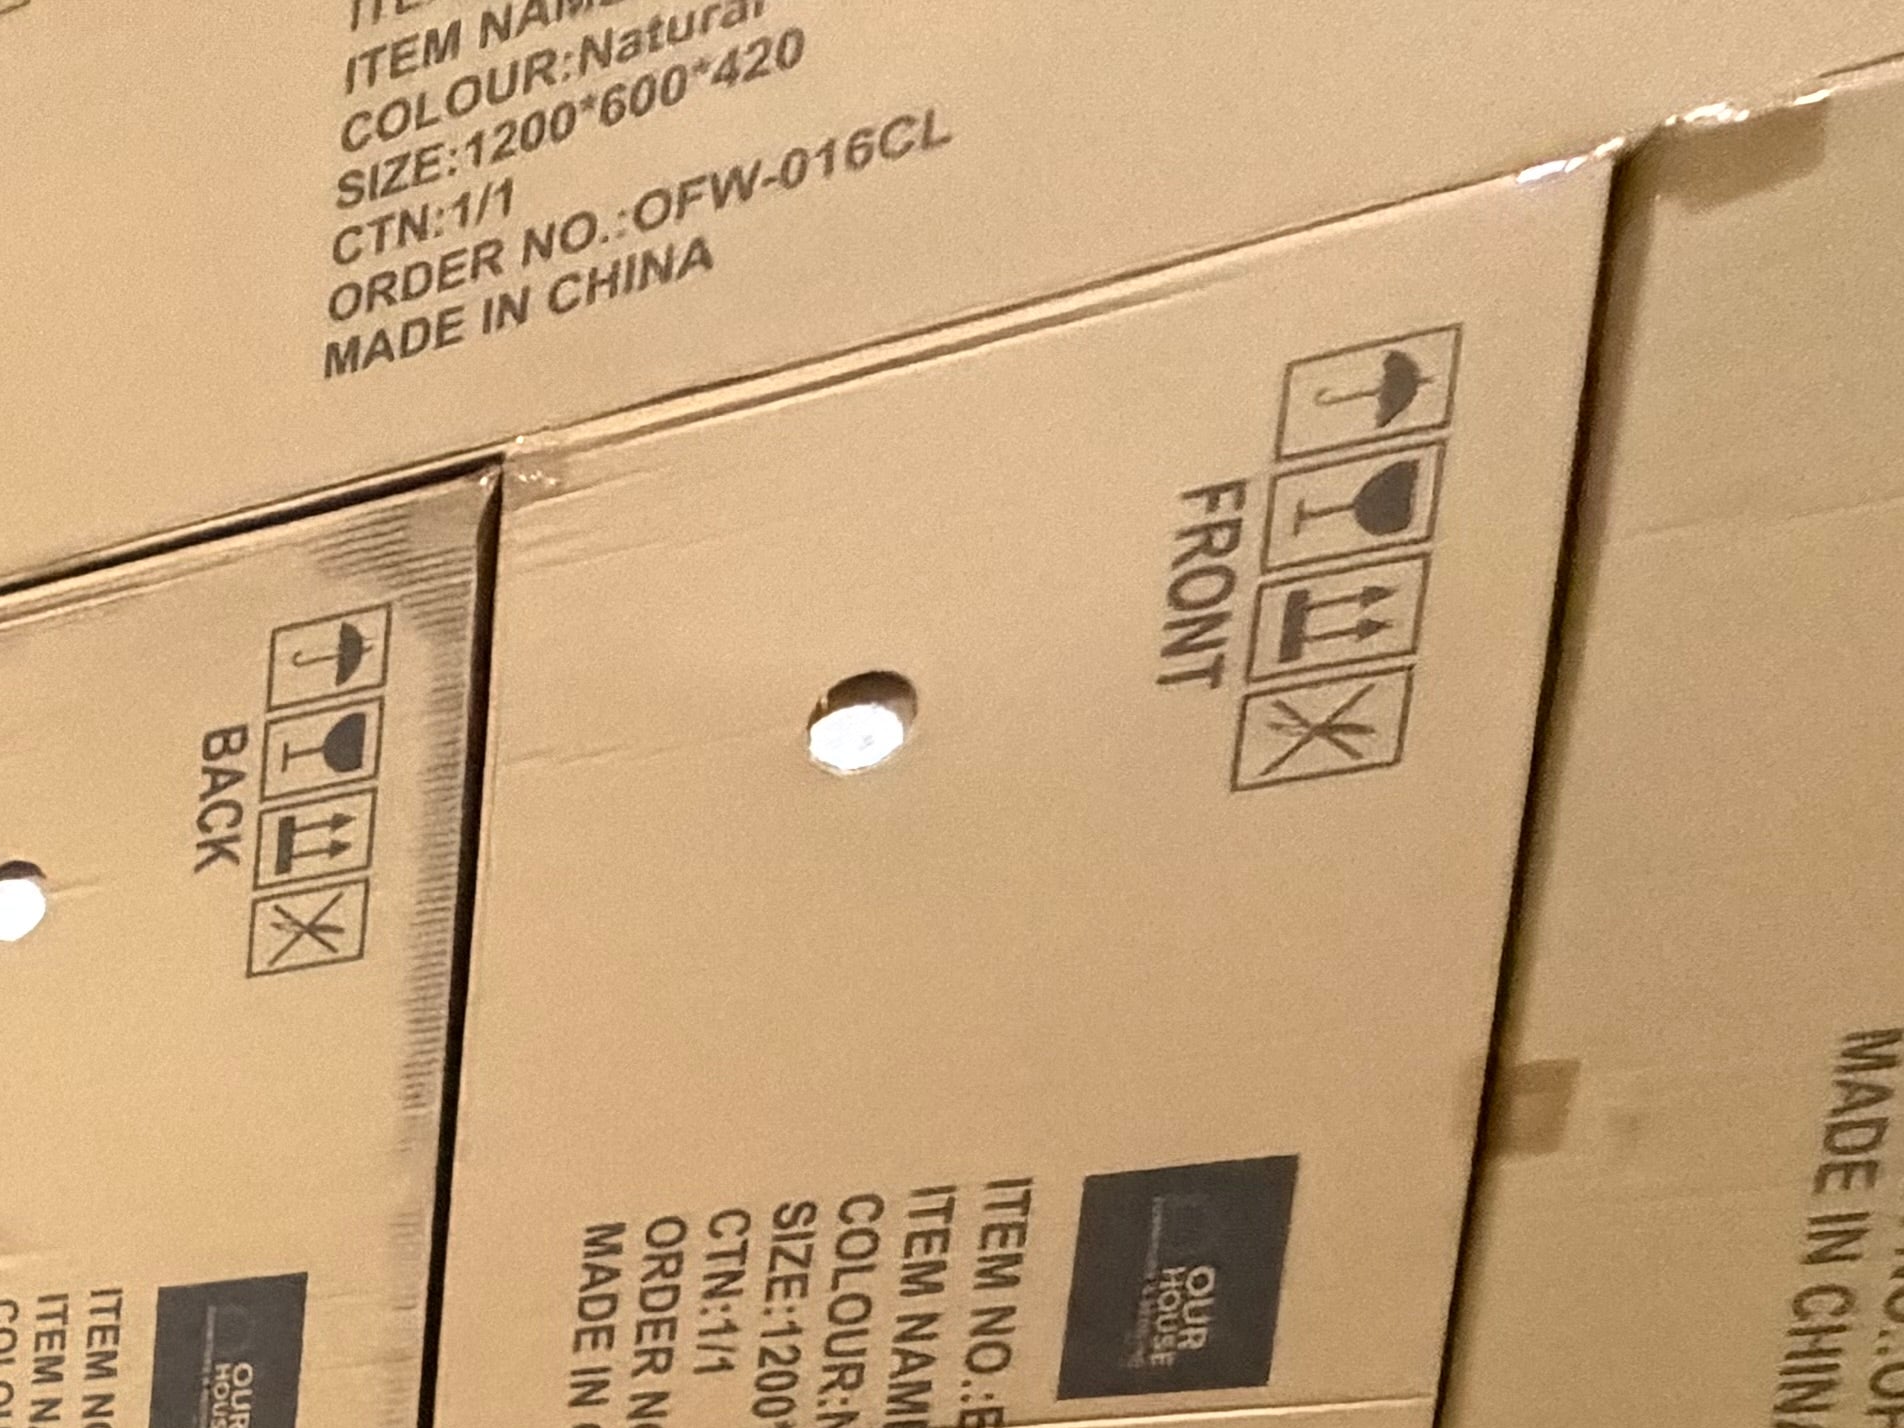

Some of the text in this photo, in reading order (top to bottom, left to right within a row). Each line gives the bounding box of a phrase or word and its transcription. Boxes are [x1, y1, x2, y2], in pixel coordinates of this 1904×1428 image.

[345, 19, 462, 95] ITEM
[328, 109, 952, 321] ORDER NO.:OFW-016CL
[332, 177, 514, 265] CTN:1/1
[324, 236, 713, 379] MADE IN CHINA
[1157, 478, 1250, 689] FRONT
[194, 723, 248, 872] BACK
[1813, 1026, 1902, 1196] MADE
[571, 1222, 626, 1356] MADE
[692, 1208, 752, 1376] CTN:1/1
[898, 1184, 958, 1300] ITEM
[972, 1176, 1034, 1292] ITEM
[1802, 1211, 1872, 1266] IN
[30, 1293, 70, 1387] ITEM
[83, 1288, 123, 1381] ITEM
[625, 1216, 687, 1379] ORDER
[1151, 1265, 1186, 1368] HOUSE
[1177, 1265, 1216, 1350] OUR
[565, 1367, 613, 1410] IN
